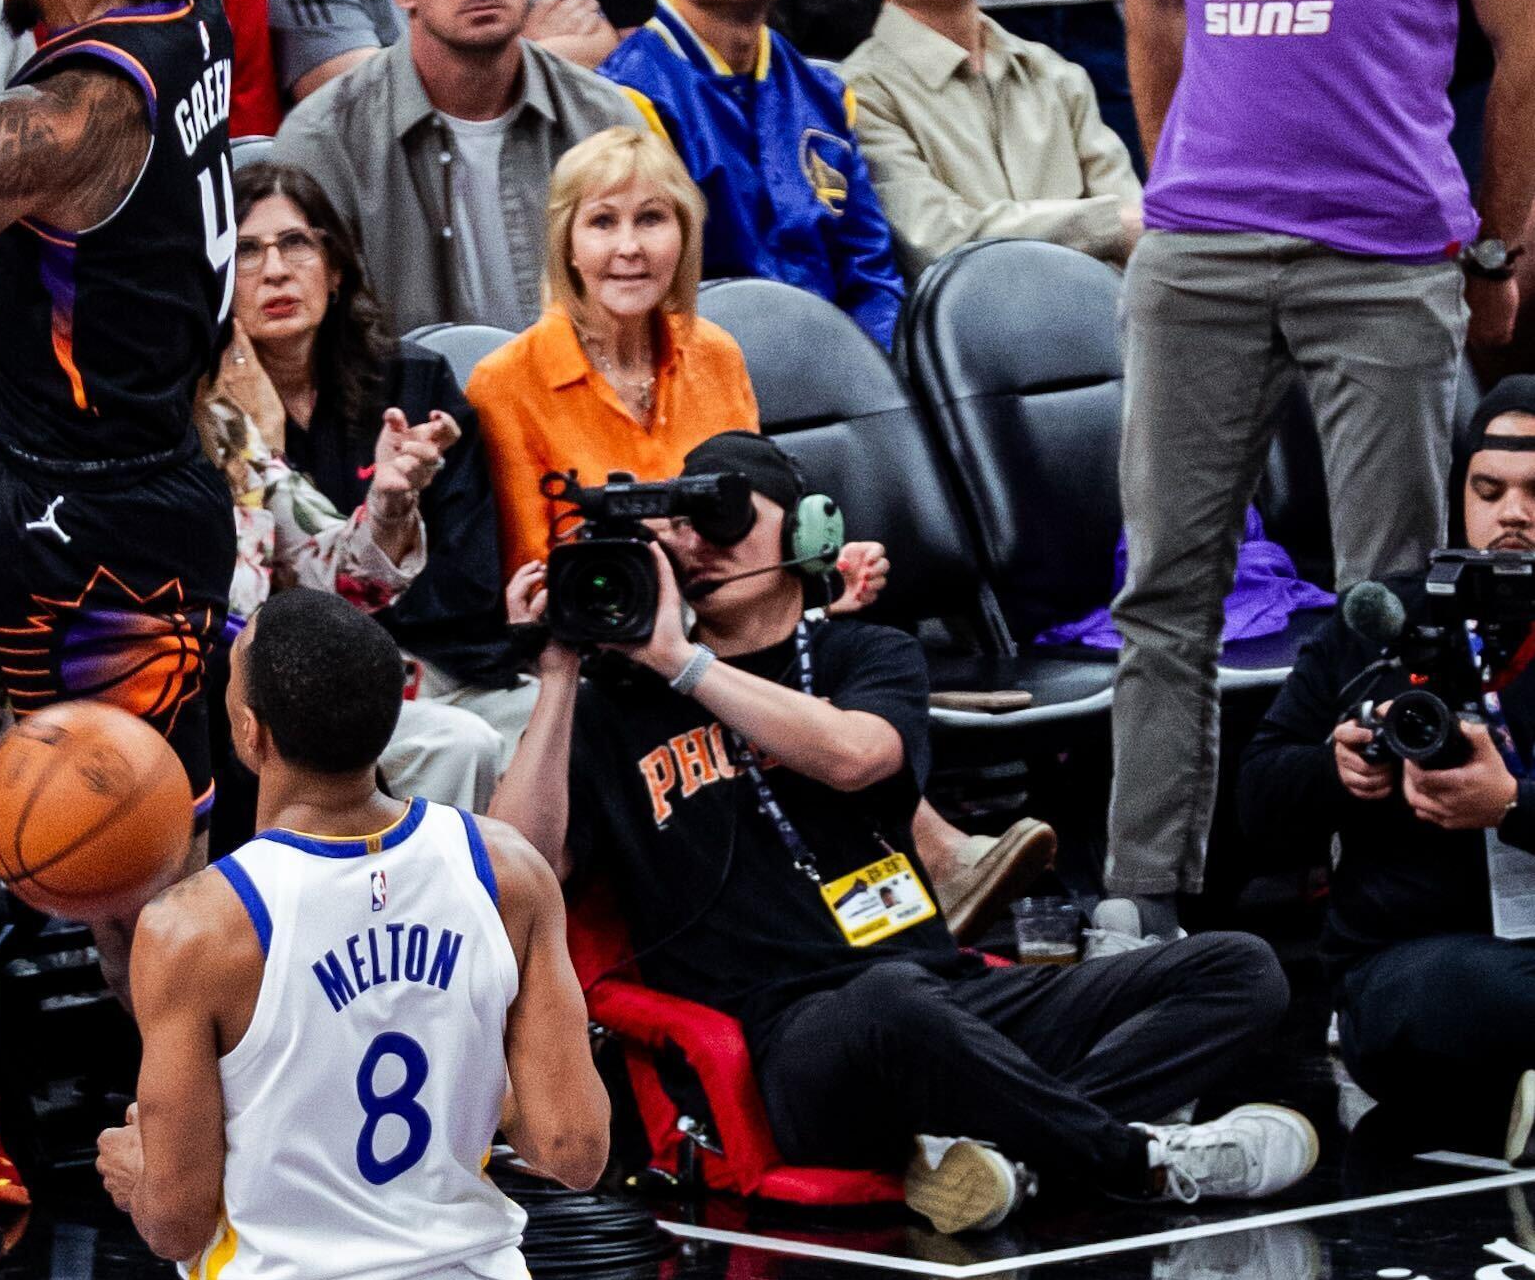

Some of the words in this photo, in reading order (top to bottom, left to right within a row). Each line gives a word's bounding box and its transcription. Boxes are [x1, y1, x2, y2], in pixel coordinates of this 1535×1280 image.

[1204, 0, 1335, 37] SUNS
[311, 922, 464, 1013] MELTON
[356, 1031, 432, 1186] 8
